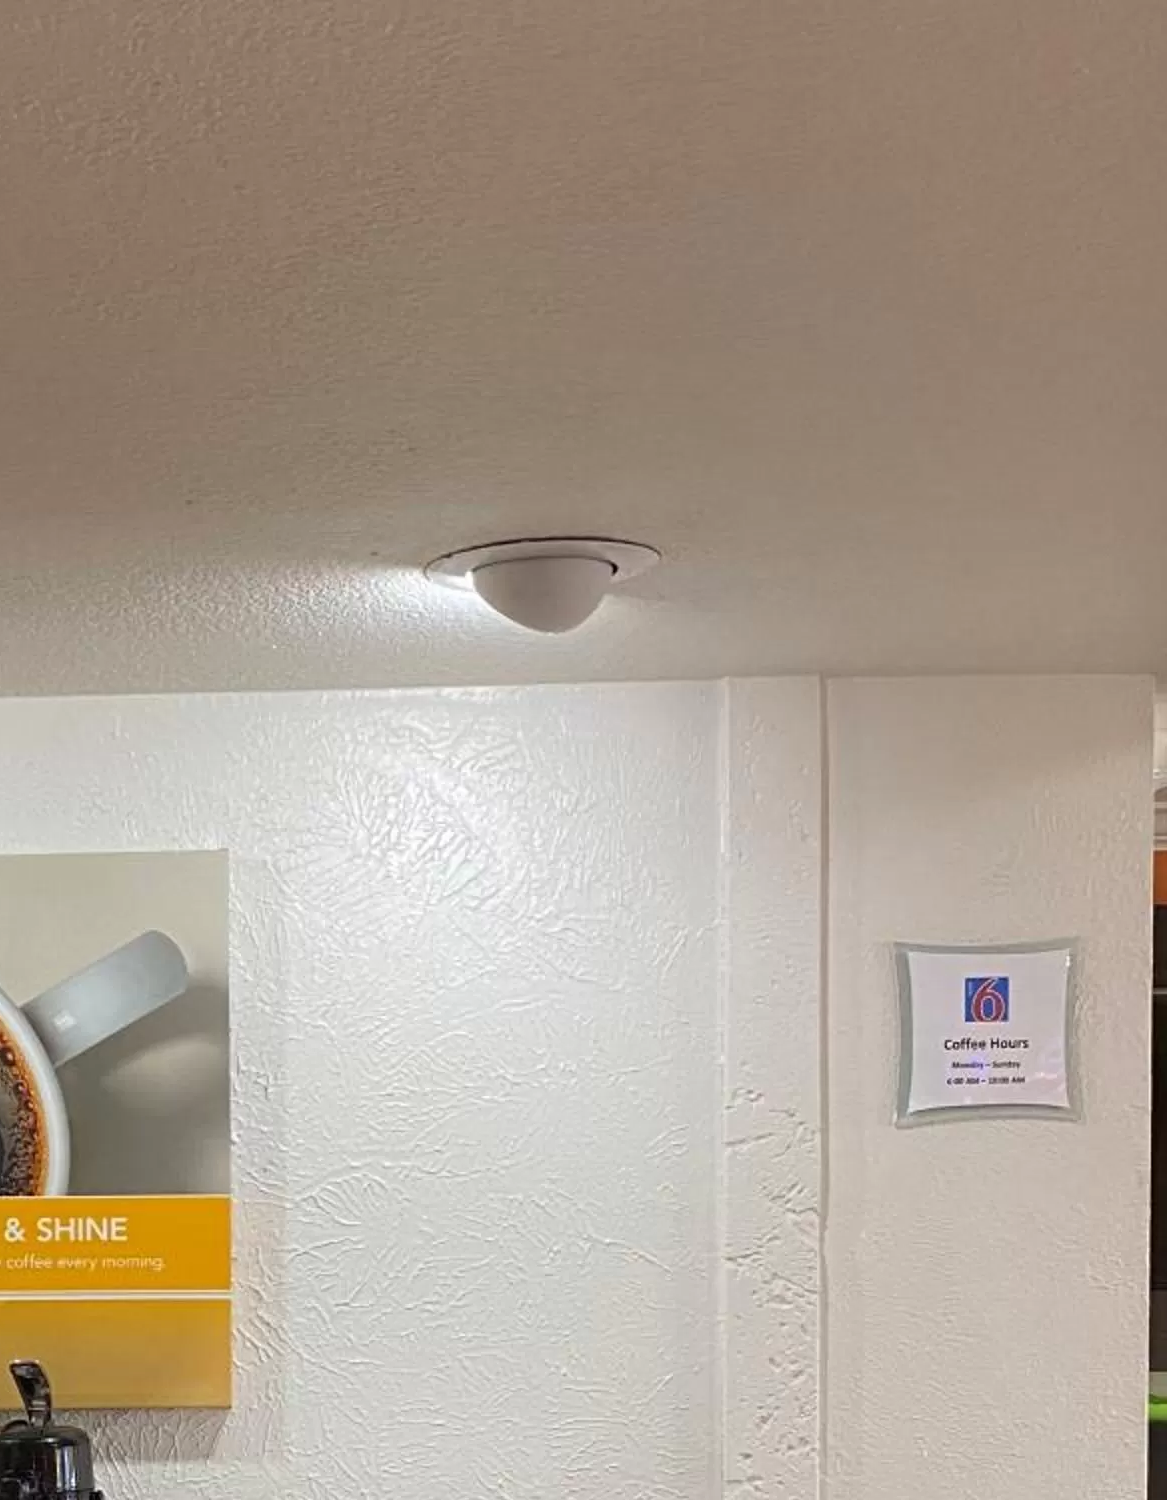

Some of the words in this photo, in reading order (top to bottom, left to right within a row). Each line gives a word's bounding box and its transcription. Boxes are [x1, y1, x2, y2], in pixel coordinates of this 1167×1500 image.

[944, 1038, 986, 1050] Coffee
[990, 1037, 1029, 1049] Hours
[4, 1217, 26, 1242] &
[36, 1216, 129, 1242] SHINE
[6, 1253, 53, 1269] coffee
[57, 1257, 98, 1270] every
[102, 1254, 166, 1271] morning.
